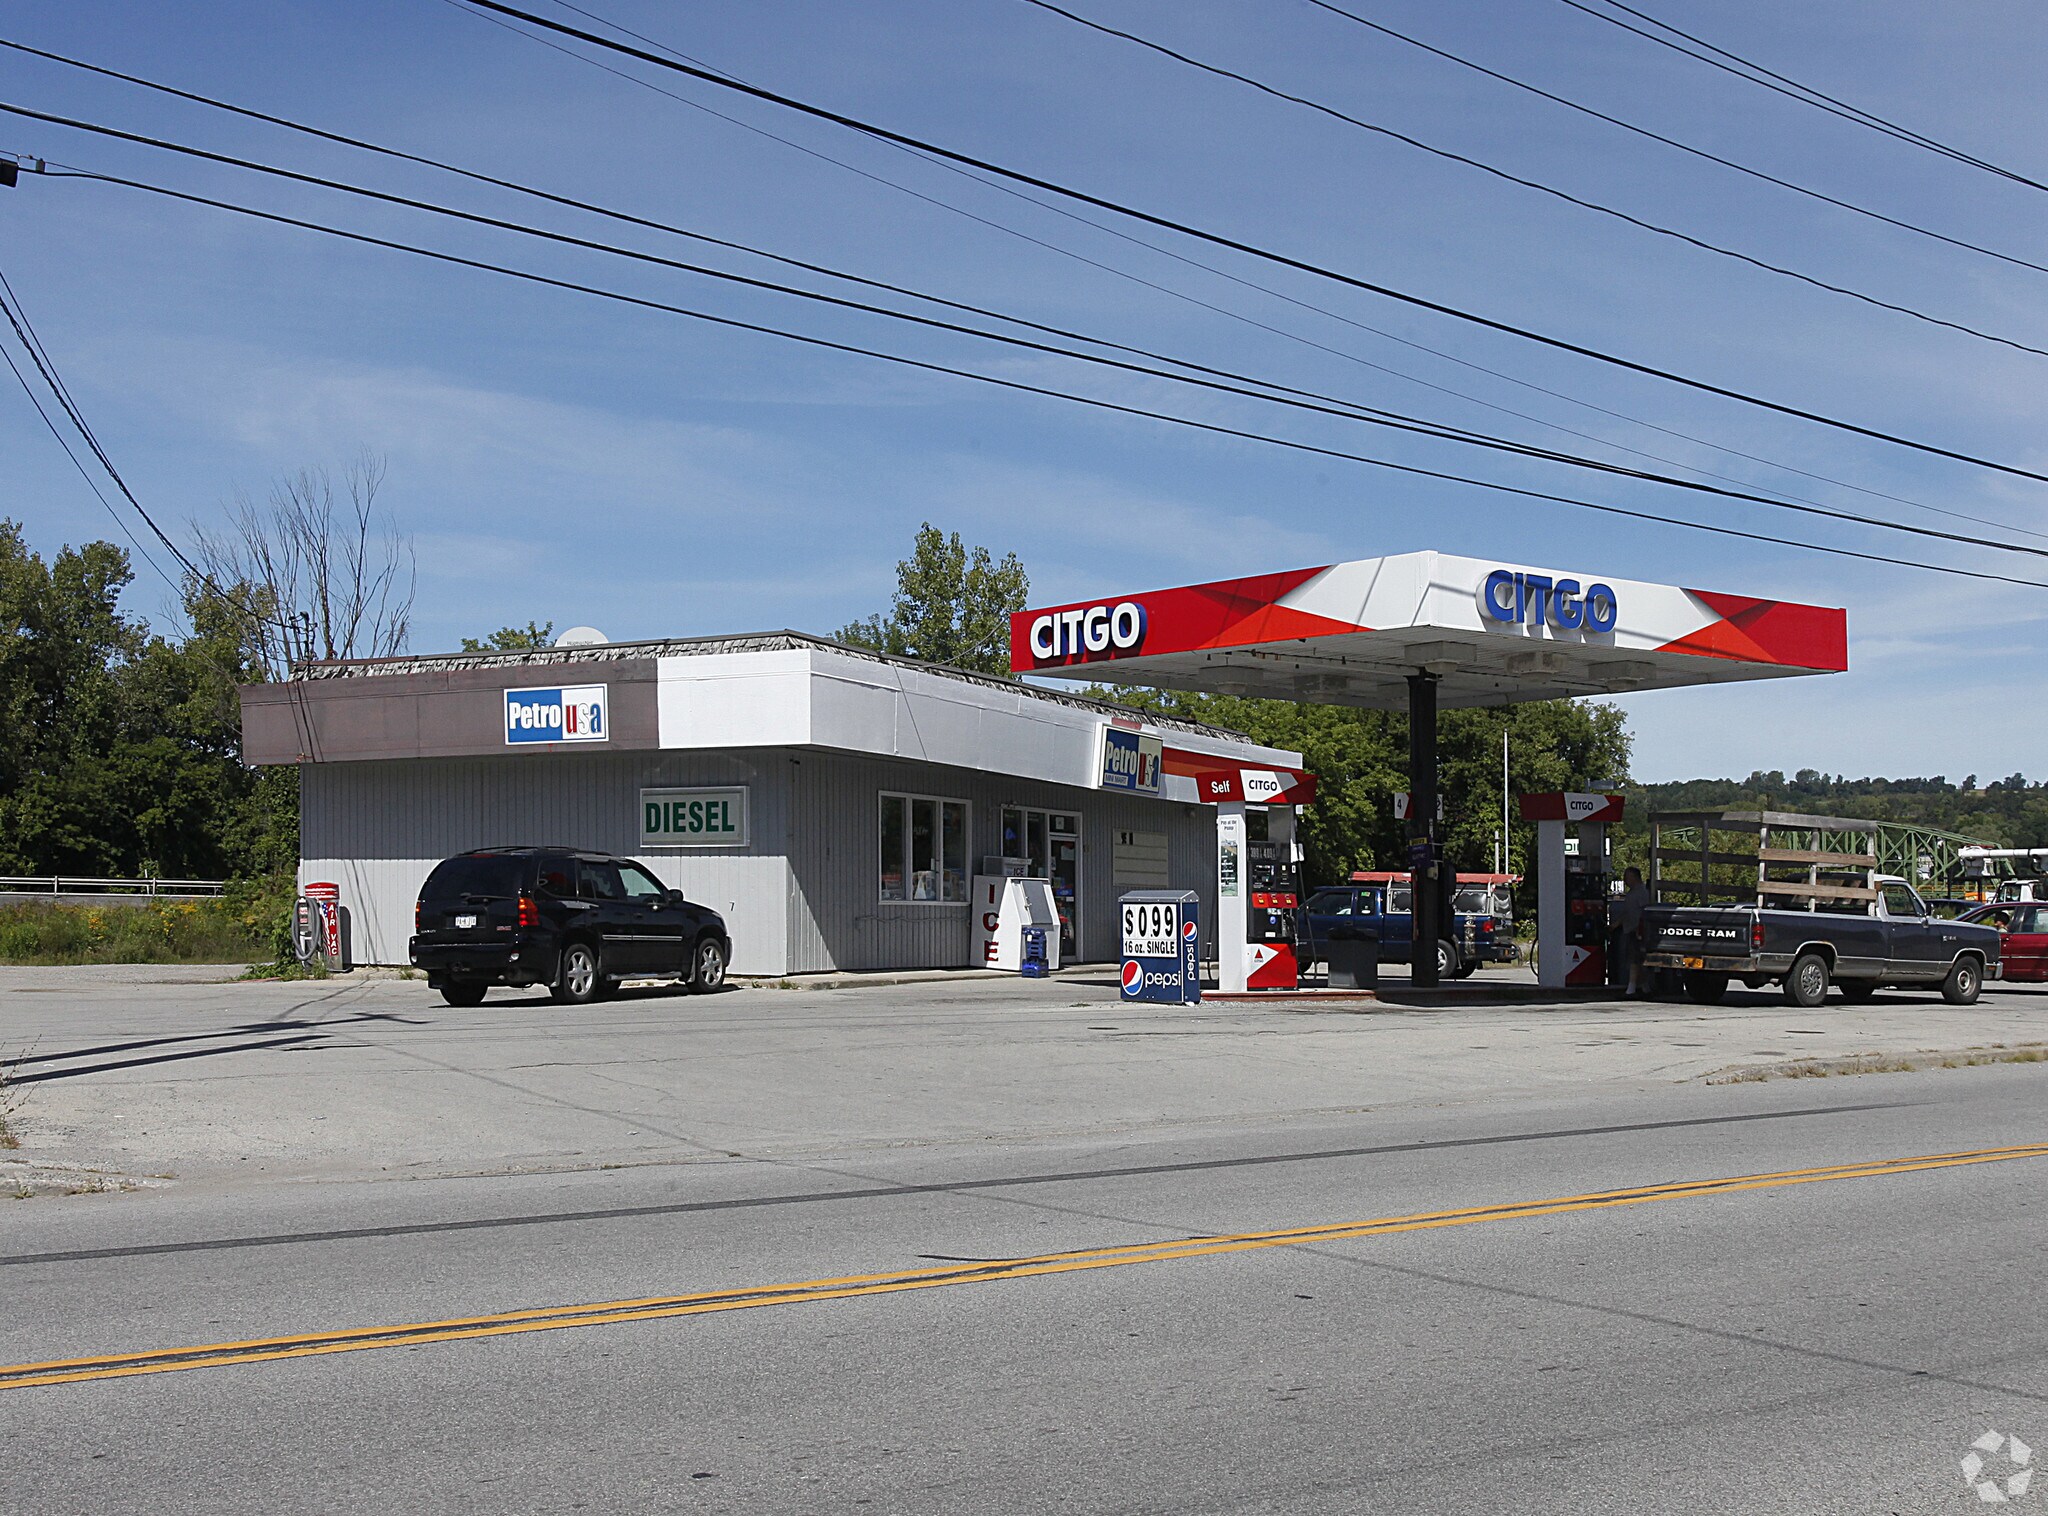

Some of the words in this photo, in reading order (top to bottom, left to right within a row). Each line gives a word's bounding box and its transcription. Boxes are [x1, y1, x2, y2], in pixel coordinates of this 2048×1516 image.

[1485, 570, 1617, 633] CITGO
[1030, 602, 1141, 660] CITGO
[509, 702, 562, 730] Petro
[1105, 741, 1138, 776] Petro
[1211, 780, 1230, 793] Self
[1248, 779, 1278, 792] CITGO
[645, 801, 735, 833] DIESEL
[1570, 801, 1594, 811] CITGO
[1013, 867, 1025, 876] ICE
[328, 904, 336, 926] AIR
[982, 883, 1000, 962] ICE
[1659, 928, 1701, 937] DODGE
[1707, 929, 1736, 938] RAM
[1125, 941, 1133, 953] 16
[1135, 944, 1145, 953] oz.
[1147, 941, 1175, 954] SINGLE
[1186, 944, 1196, 981] pepsi
[1145, 970, 1182, 989] pepsi
